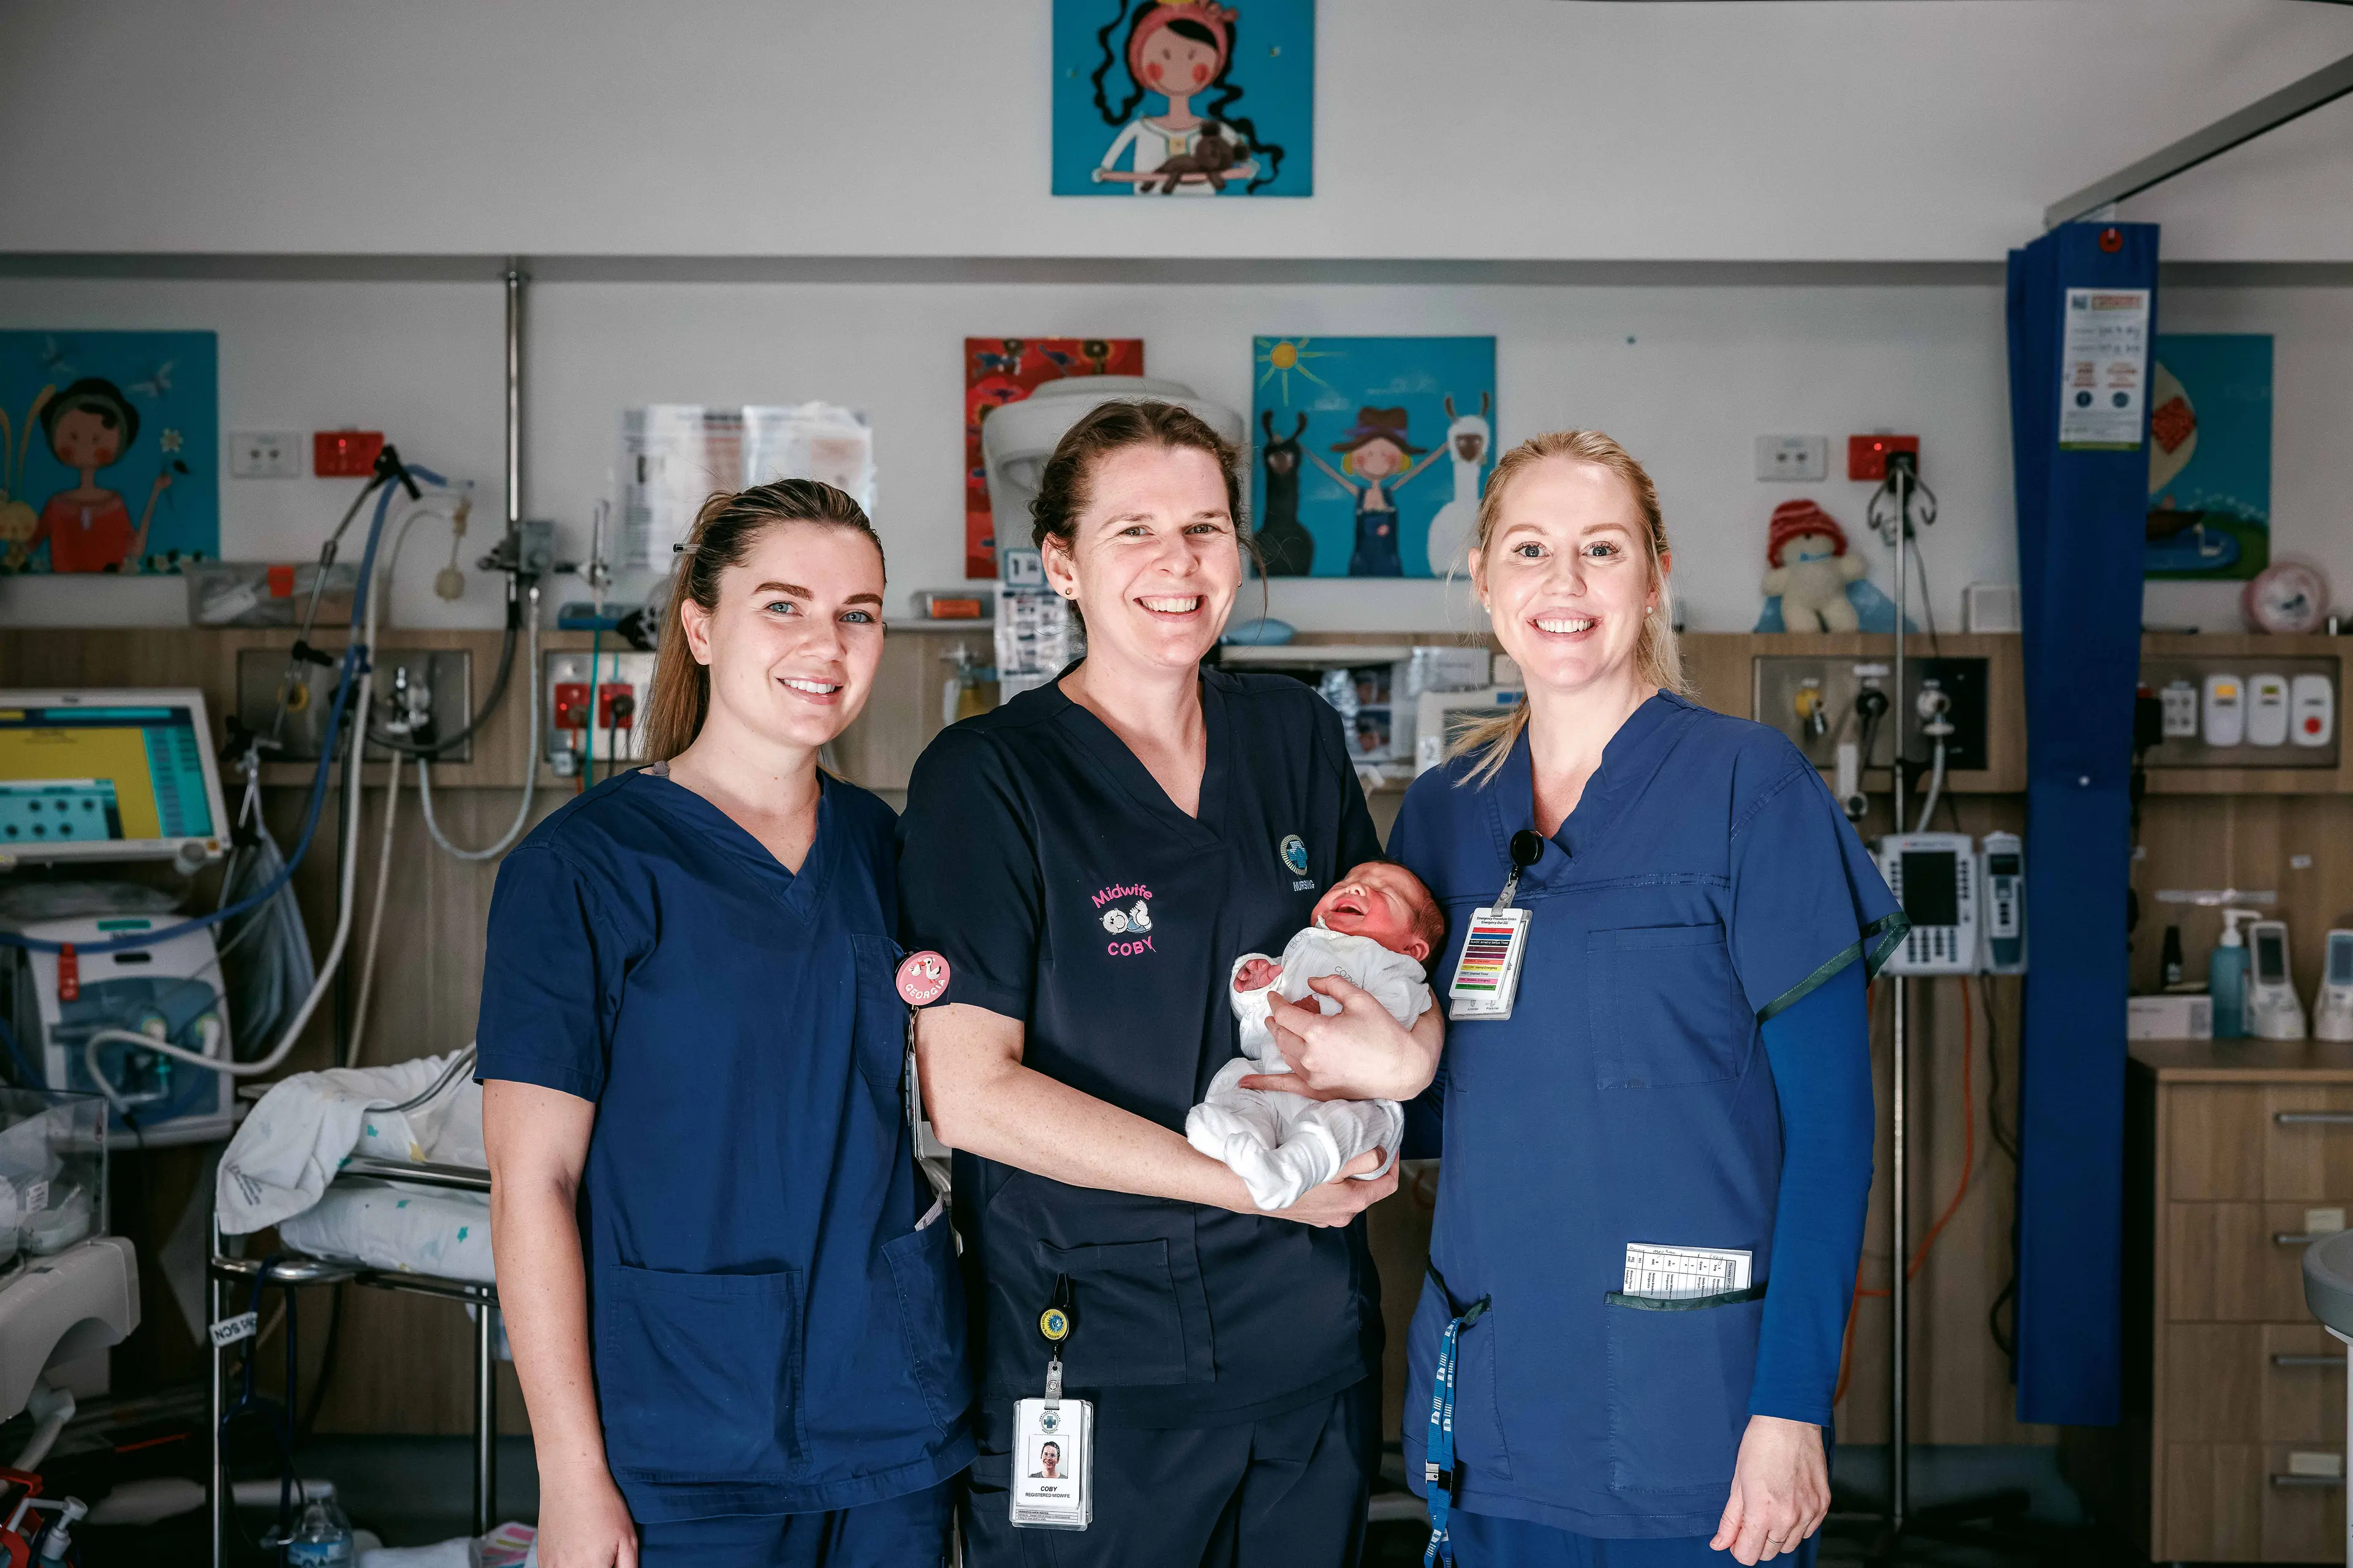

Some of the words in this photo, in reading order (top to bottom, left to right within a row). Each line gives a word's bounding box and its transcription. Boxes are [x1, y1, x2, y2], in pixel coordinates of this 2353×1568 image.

[1091, 883, 1153, 909] Midwife
[1293, 880, 1314, 892] NURSING
[1108, 935, 1153, 956] COBY
[905, 979, 945, 999] GEORGIA
